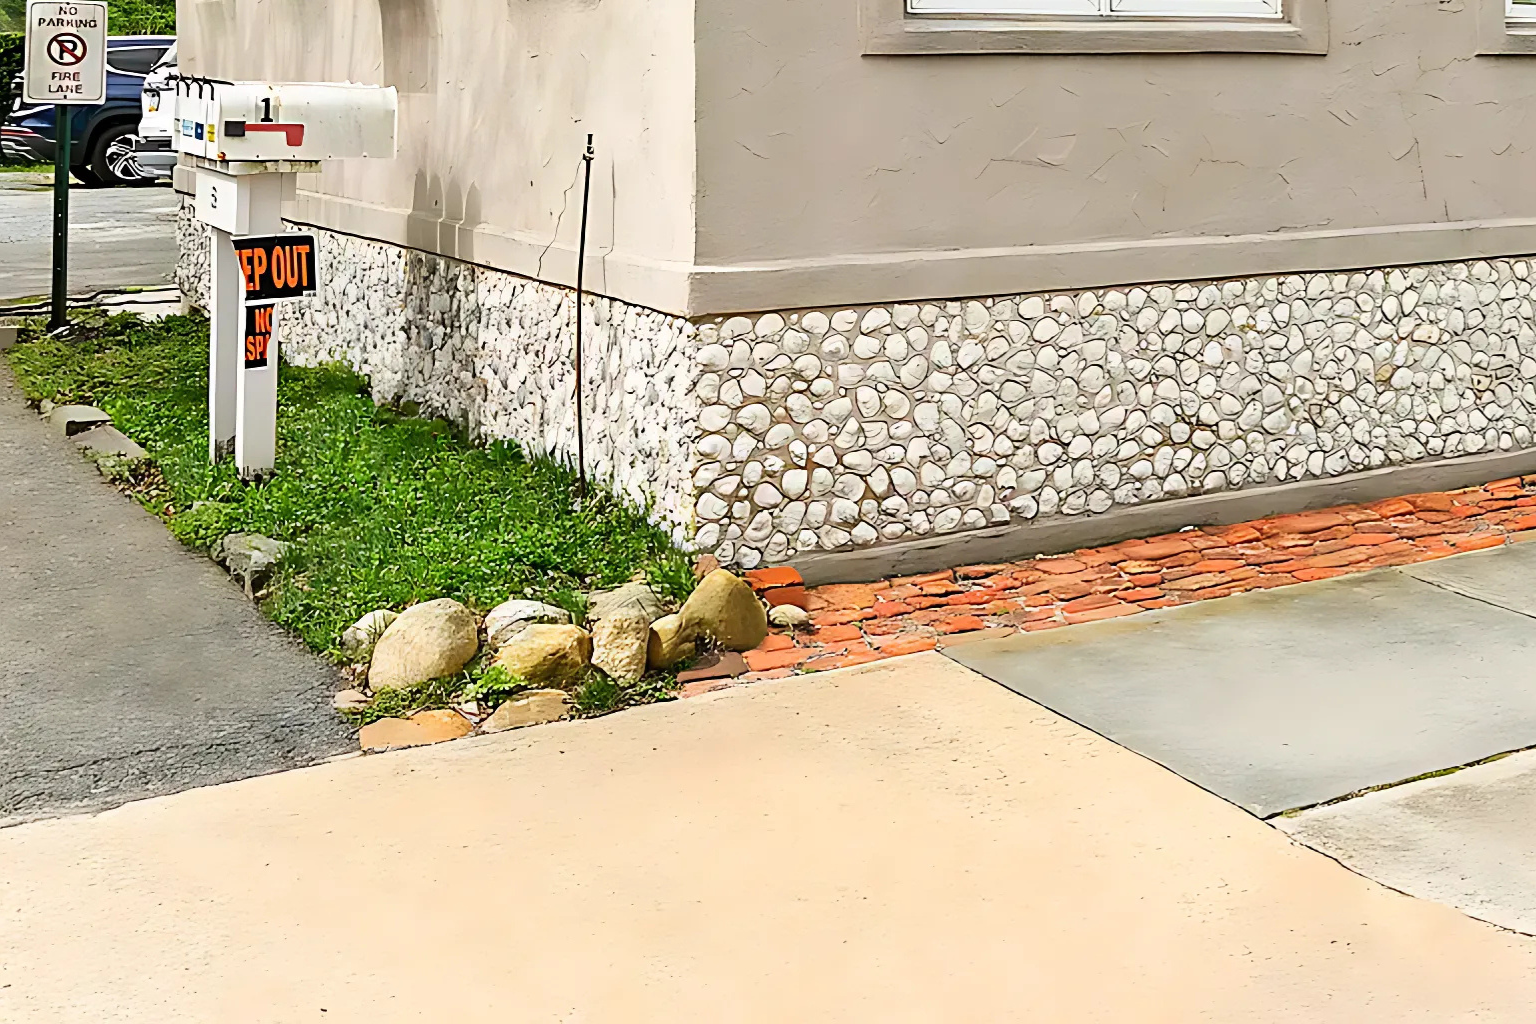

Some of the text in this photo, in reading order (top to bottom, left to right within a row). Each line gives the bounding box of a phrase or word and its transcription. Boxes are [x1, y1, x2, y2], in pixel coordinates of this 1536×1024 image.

[58, 6, 78, 16] NO
[38, 17, 97, 28] PARKING
[51, 71, 81, 82] FIRE
[48, 84, 83, 94] LANE
[261, 98, 273, 123] 1
[235, 245, 310, 291] EP OUT
